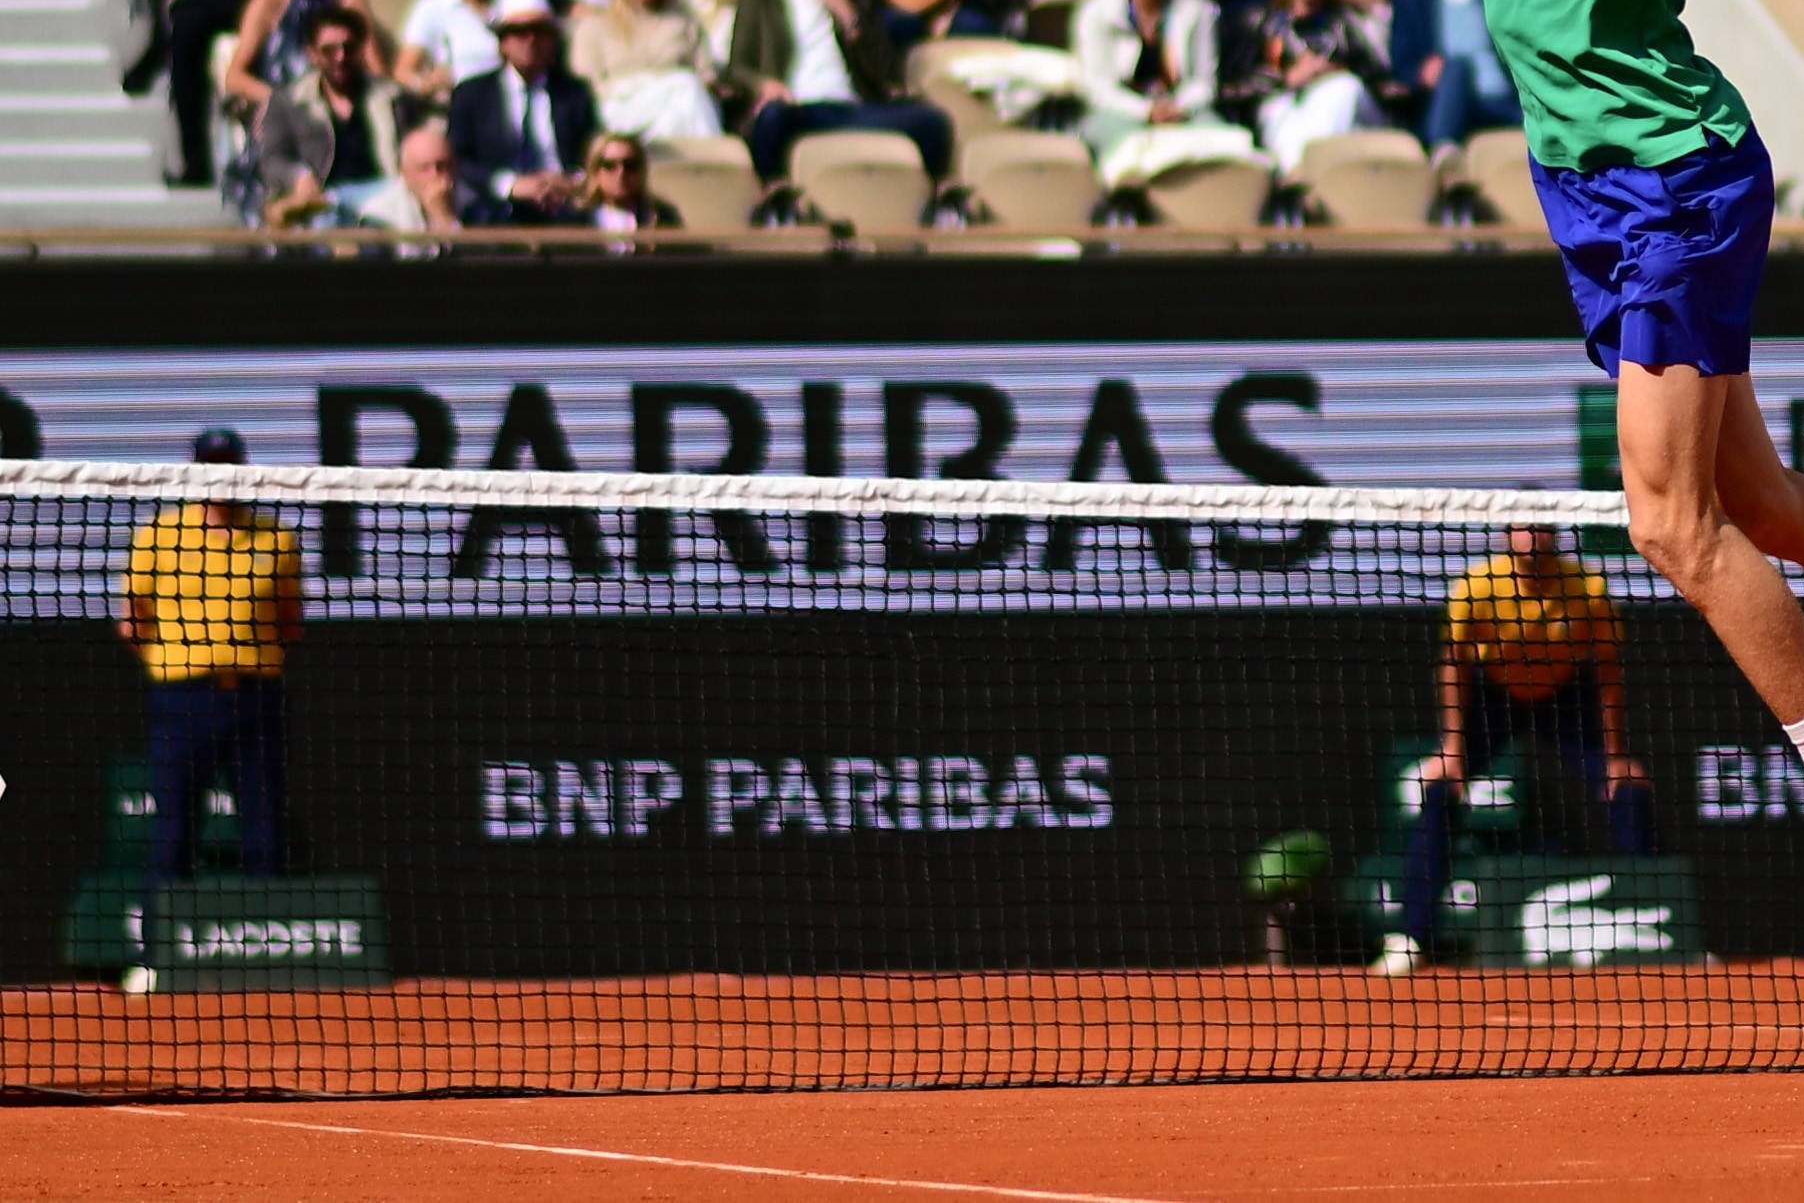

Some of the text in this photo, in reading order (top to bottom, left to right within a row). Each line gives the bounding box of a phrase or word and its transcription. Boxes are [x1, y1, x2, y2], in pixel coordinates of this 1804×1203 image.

[317, 370, 1331, 578] PARIBAS
[482, 755, 1114, 839] BNP PARIBAS
[174, 920, 364, 959] LACOSTE
